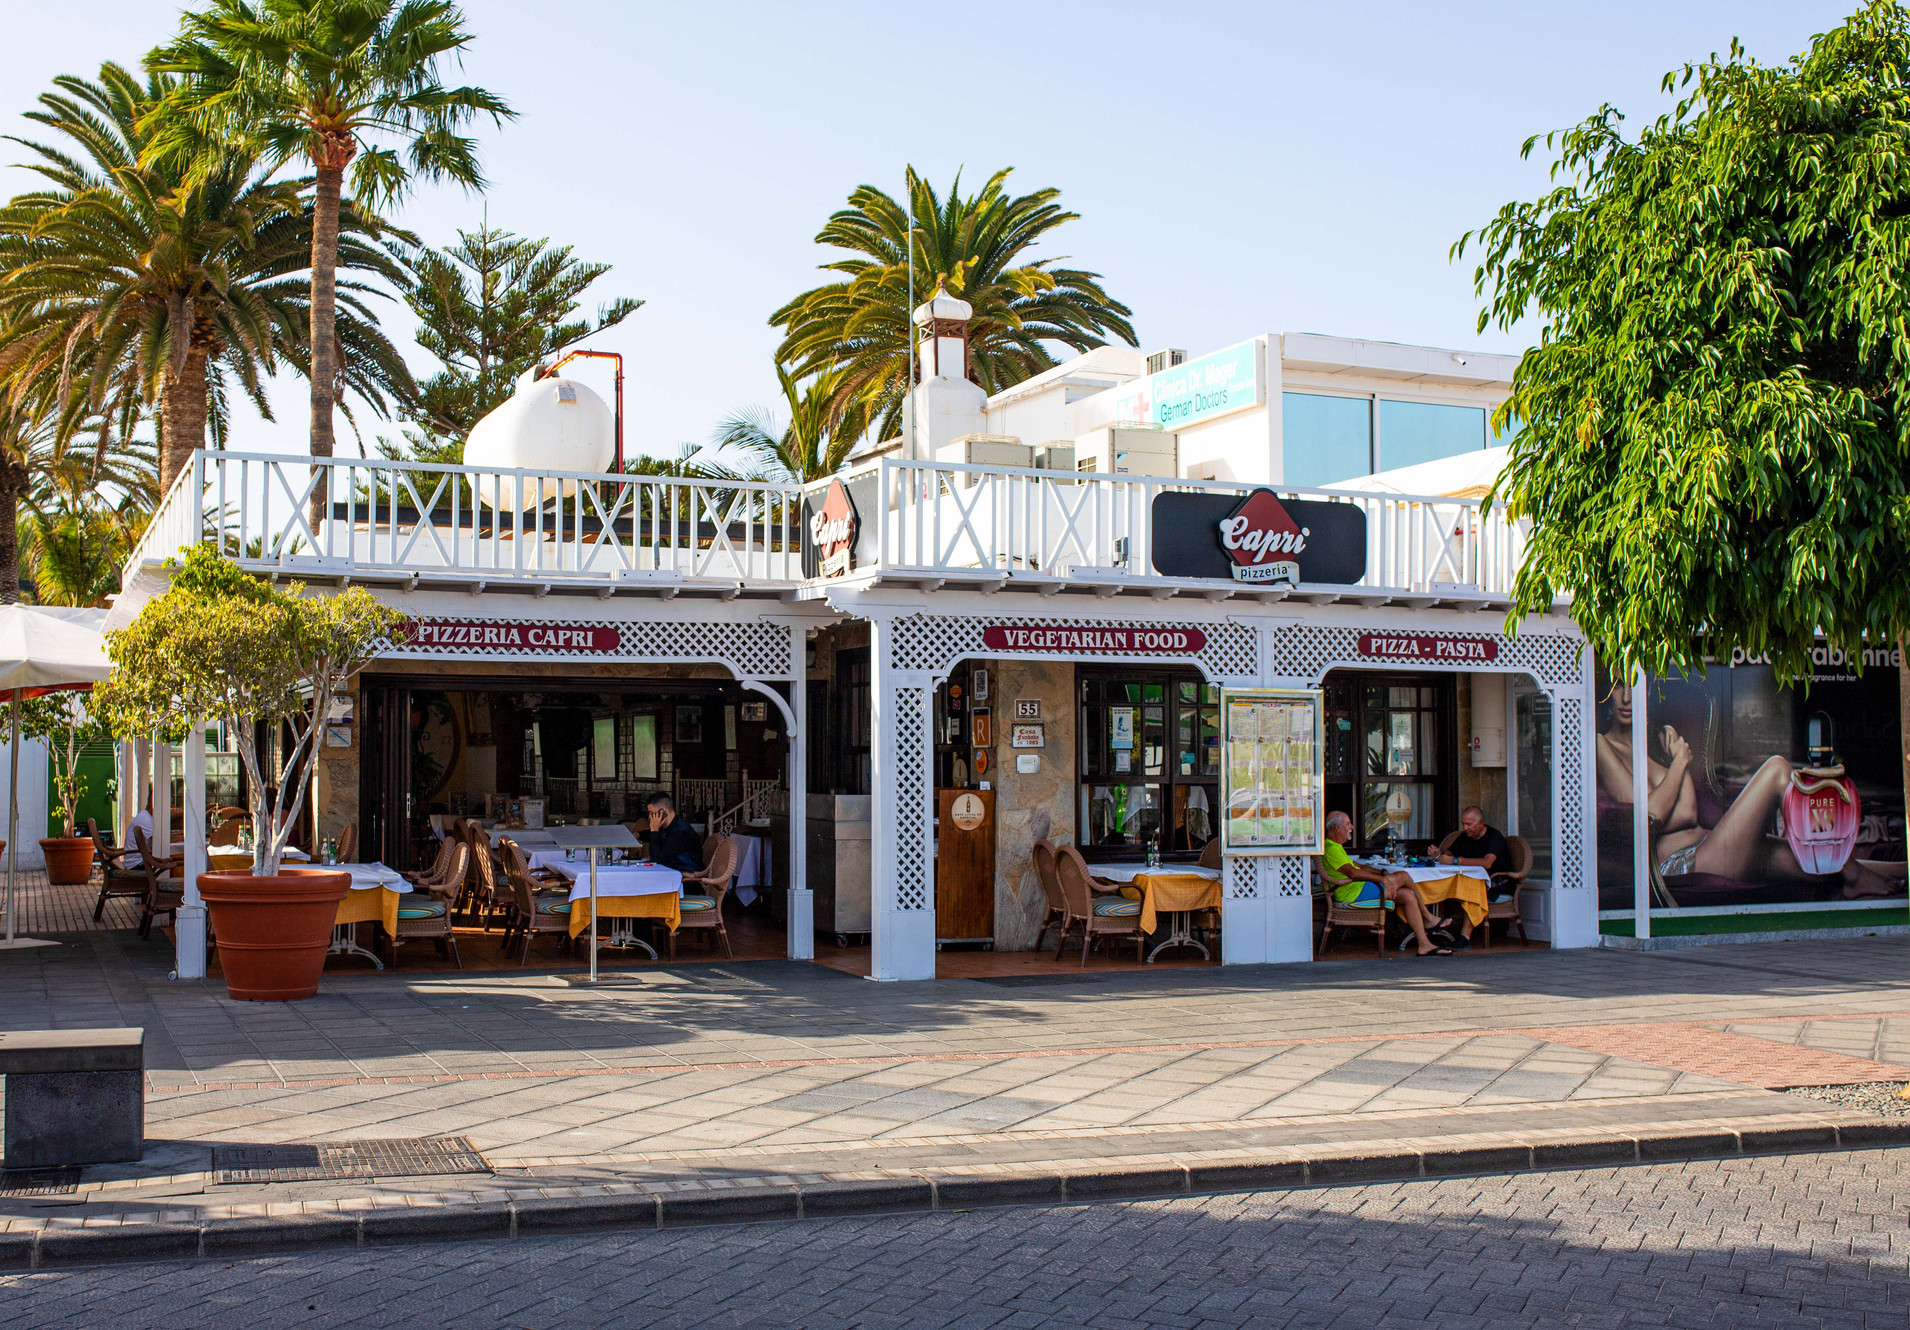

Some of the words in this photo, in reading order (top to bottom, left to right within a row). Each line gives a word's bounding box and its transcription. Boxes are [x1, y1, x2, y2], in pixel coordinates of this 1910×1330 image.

[1188, 370, 1203, 392] Dr.
[1205, 361, 1238, 388] Mager
[1161, 400, 1193, 423] German
[1195, 389, 1228, 412] Doctors
[810, 510, 853, 556] Capri
[1219, 515, 1310, 563] Capri
[1240, 564, 1288, 580] pizzería
[417, 625, 522, 645] PIZZERIA
[528, 628, 594, 647] CAPRI
[1003, 629, 1127, 648] VEGETARIAN
[1134, 632, 1188, 649] FOOD
[1370, 638, 1420, 655] PIZZA
[1436, 640, 1486, 658] PASTA
[1847, 674, 1857, 682] her
[1020, 704, 1036, 715] 55
[976, 718, 986, 742] R
[1810, 798, 1835, 808] PURE
[1811, 808, 1835, 833] XS
